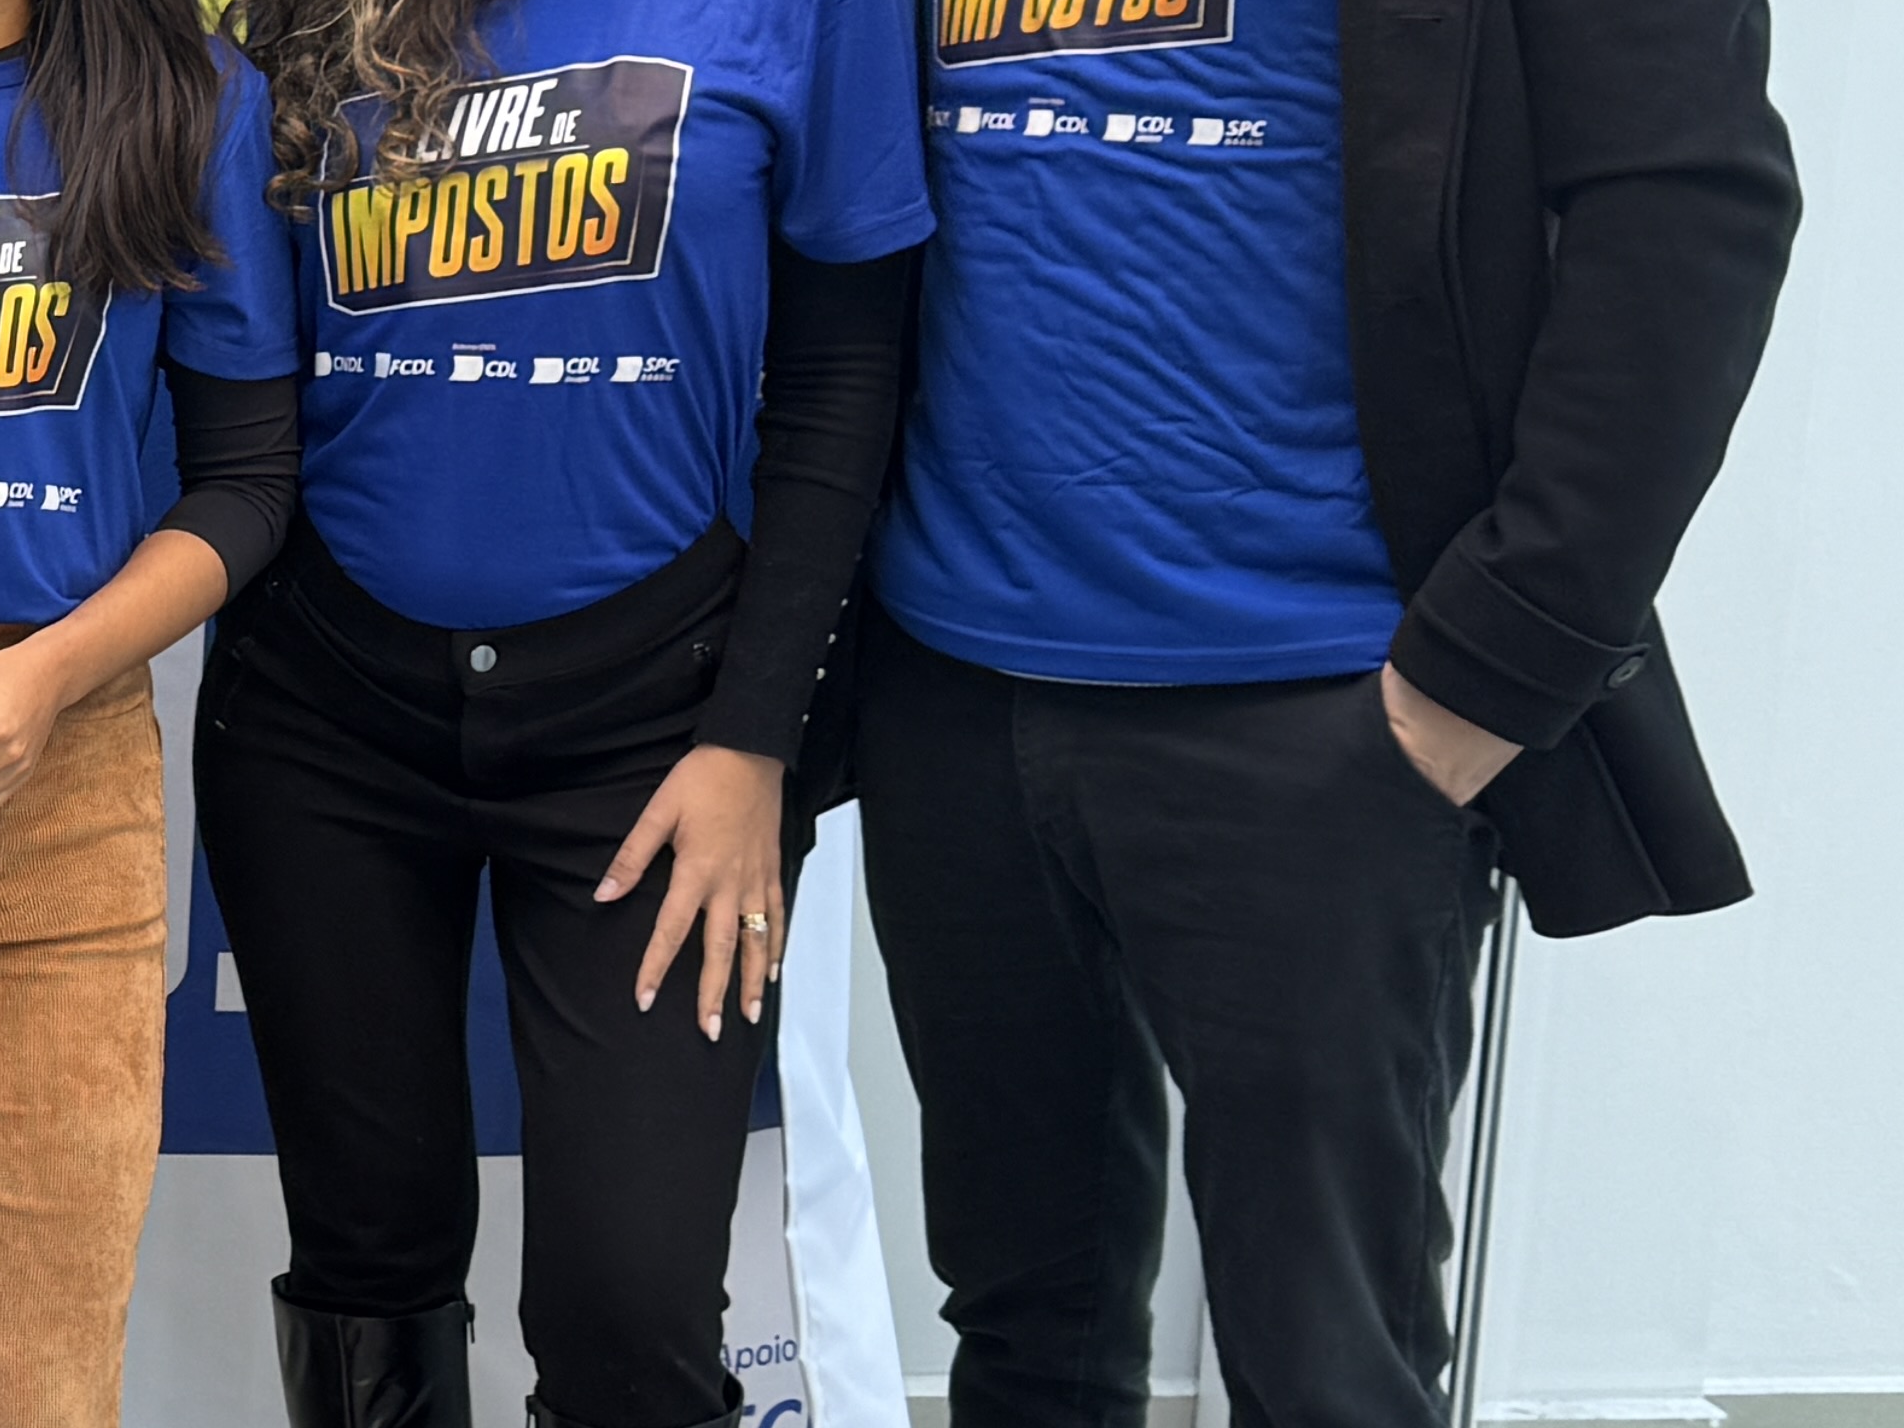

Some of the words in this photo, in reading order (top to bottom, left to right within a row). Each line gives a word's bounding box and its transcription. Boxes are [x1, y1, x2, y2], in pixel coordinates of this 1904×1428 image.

[550, 110, 581, 145] DE
[1055, 116, 1089, 134] CDL
[1137, 116, 1174, 134] CDL
[1226, 120, 1266, 137] SPC
[331, 148, 628, 295] IMPOSTOS
[389, 359, 435, 375] FCDL
[485, 361, 517, 378] CDL
[566, 357, 600, 373] CDL
[643, 357, 680, 372] SPC
[9, 482, 33, 499] CDL
